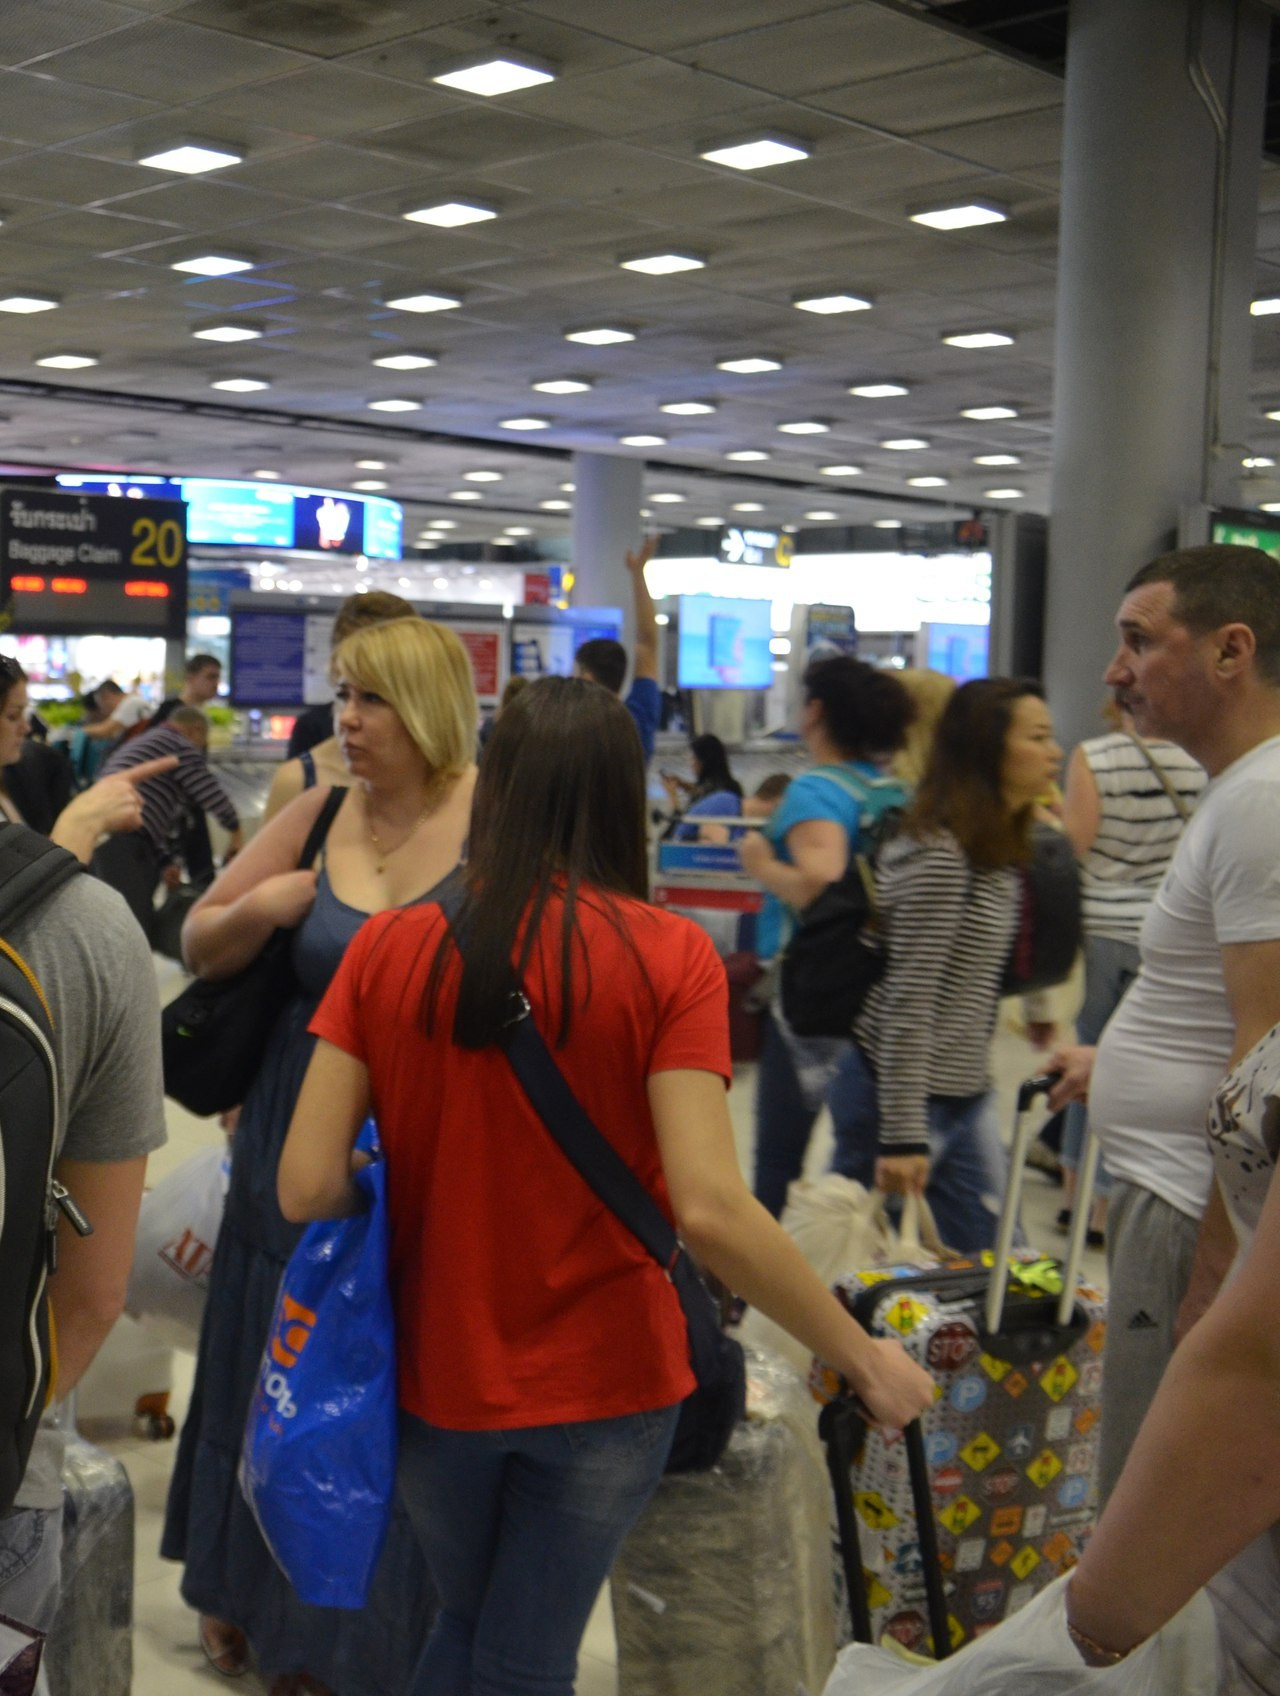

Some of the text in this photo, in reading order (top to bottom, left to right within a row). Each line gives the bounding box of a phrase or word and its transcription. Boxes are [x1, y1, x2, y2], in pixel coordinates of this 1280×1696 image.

[8, 540, 121, 565] Baggage Claim
[131, 517, 183, 568] 20
[929, 1336, 976, 1363] STOP
[959, 1381, 980, 1408] P
[930, 1438, 951, 1463] P
